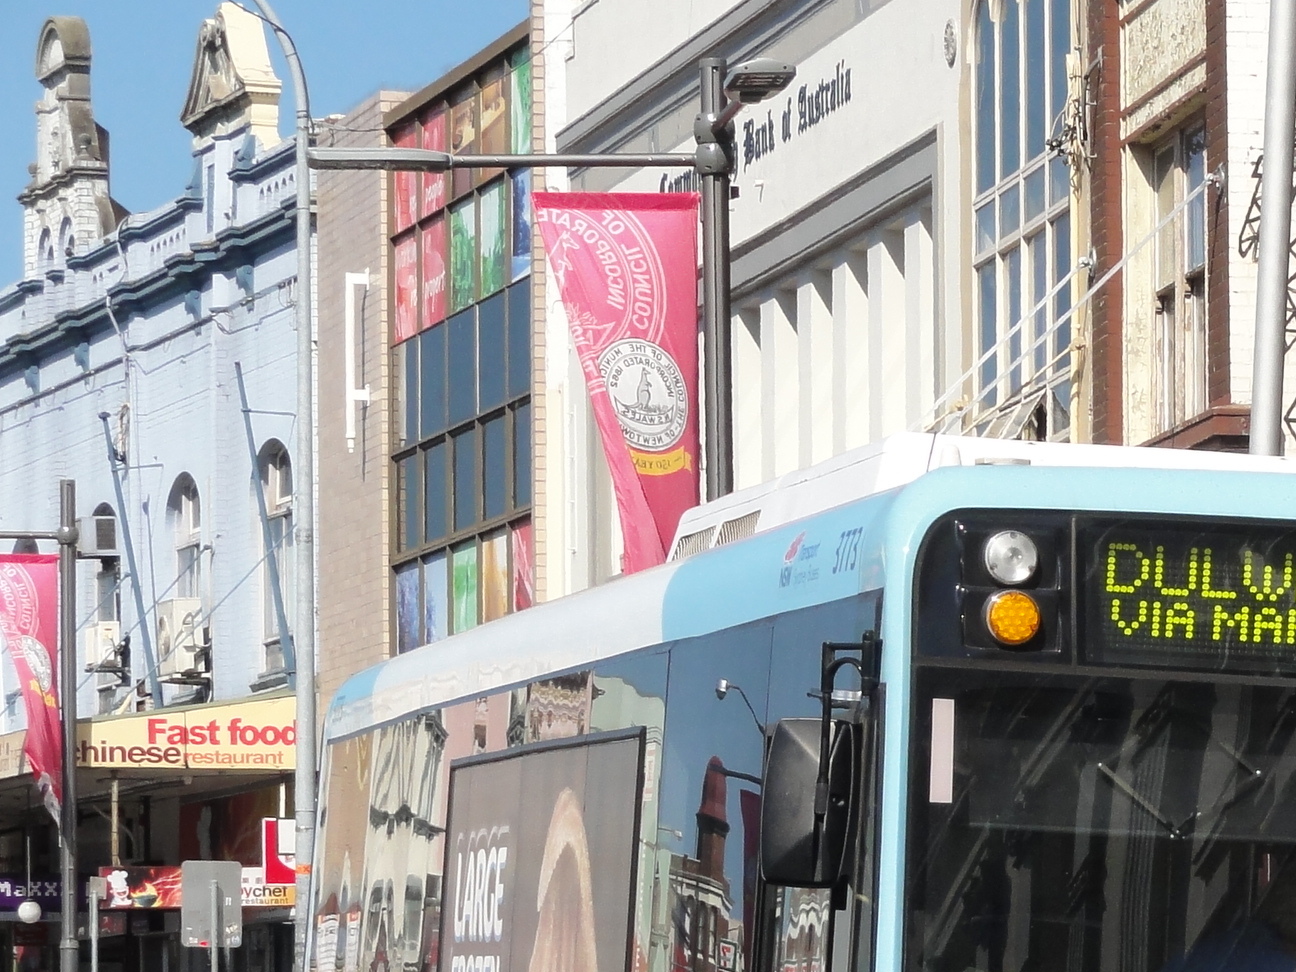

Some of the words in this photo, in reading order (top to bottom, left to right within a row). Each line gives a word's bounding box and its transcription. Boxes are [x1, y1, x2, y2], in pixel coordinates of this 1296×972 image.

[743, 109, 775, 173] Bank
[781, 97, 791, 143] of
[797, 59, 852, 135] Australia
[1109, 597, 1195, 640] VIA
[147, 718, 221, 746] Fast
[228, 717, 296, 746] food
[186, 749, 284, 765] restaurant
[240, 886, 288, 898] ychef
[454, 846, 508, 943] LARGE
